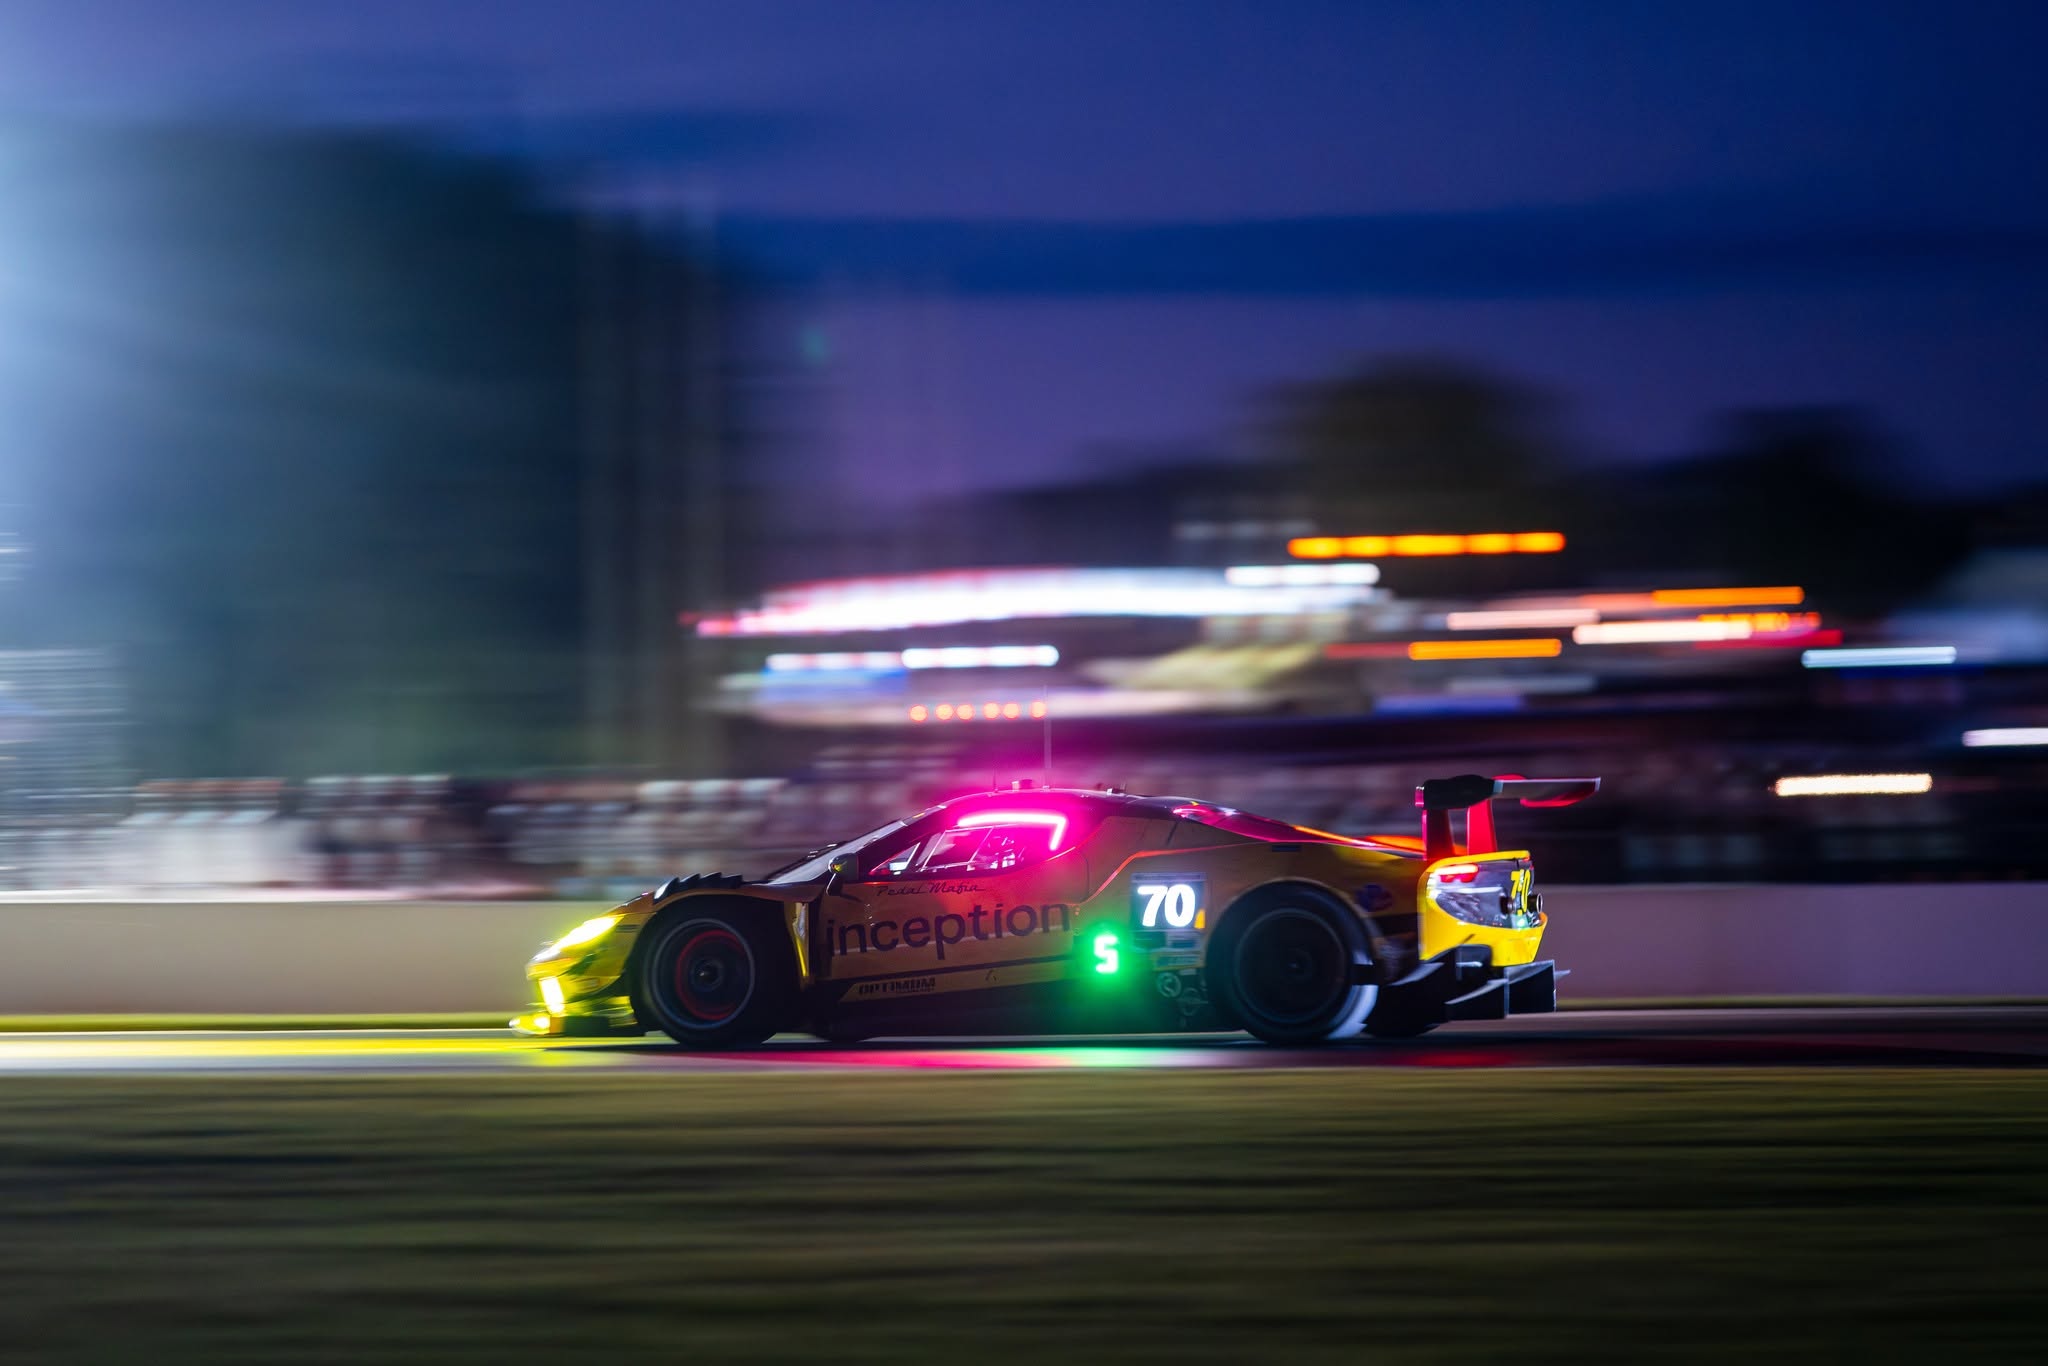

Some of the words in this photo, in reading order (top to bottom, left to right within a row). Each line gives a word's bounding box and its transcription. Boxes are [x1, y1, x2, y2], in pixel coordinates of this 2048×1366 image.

[928, 881, 985, 894] Mafia
[1137, 884, 1196, 927] 70
[1511, 869, 1530, 912] 70
[826, 903, 1071, 960] inception
